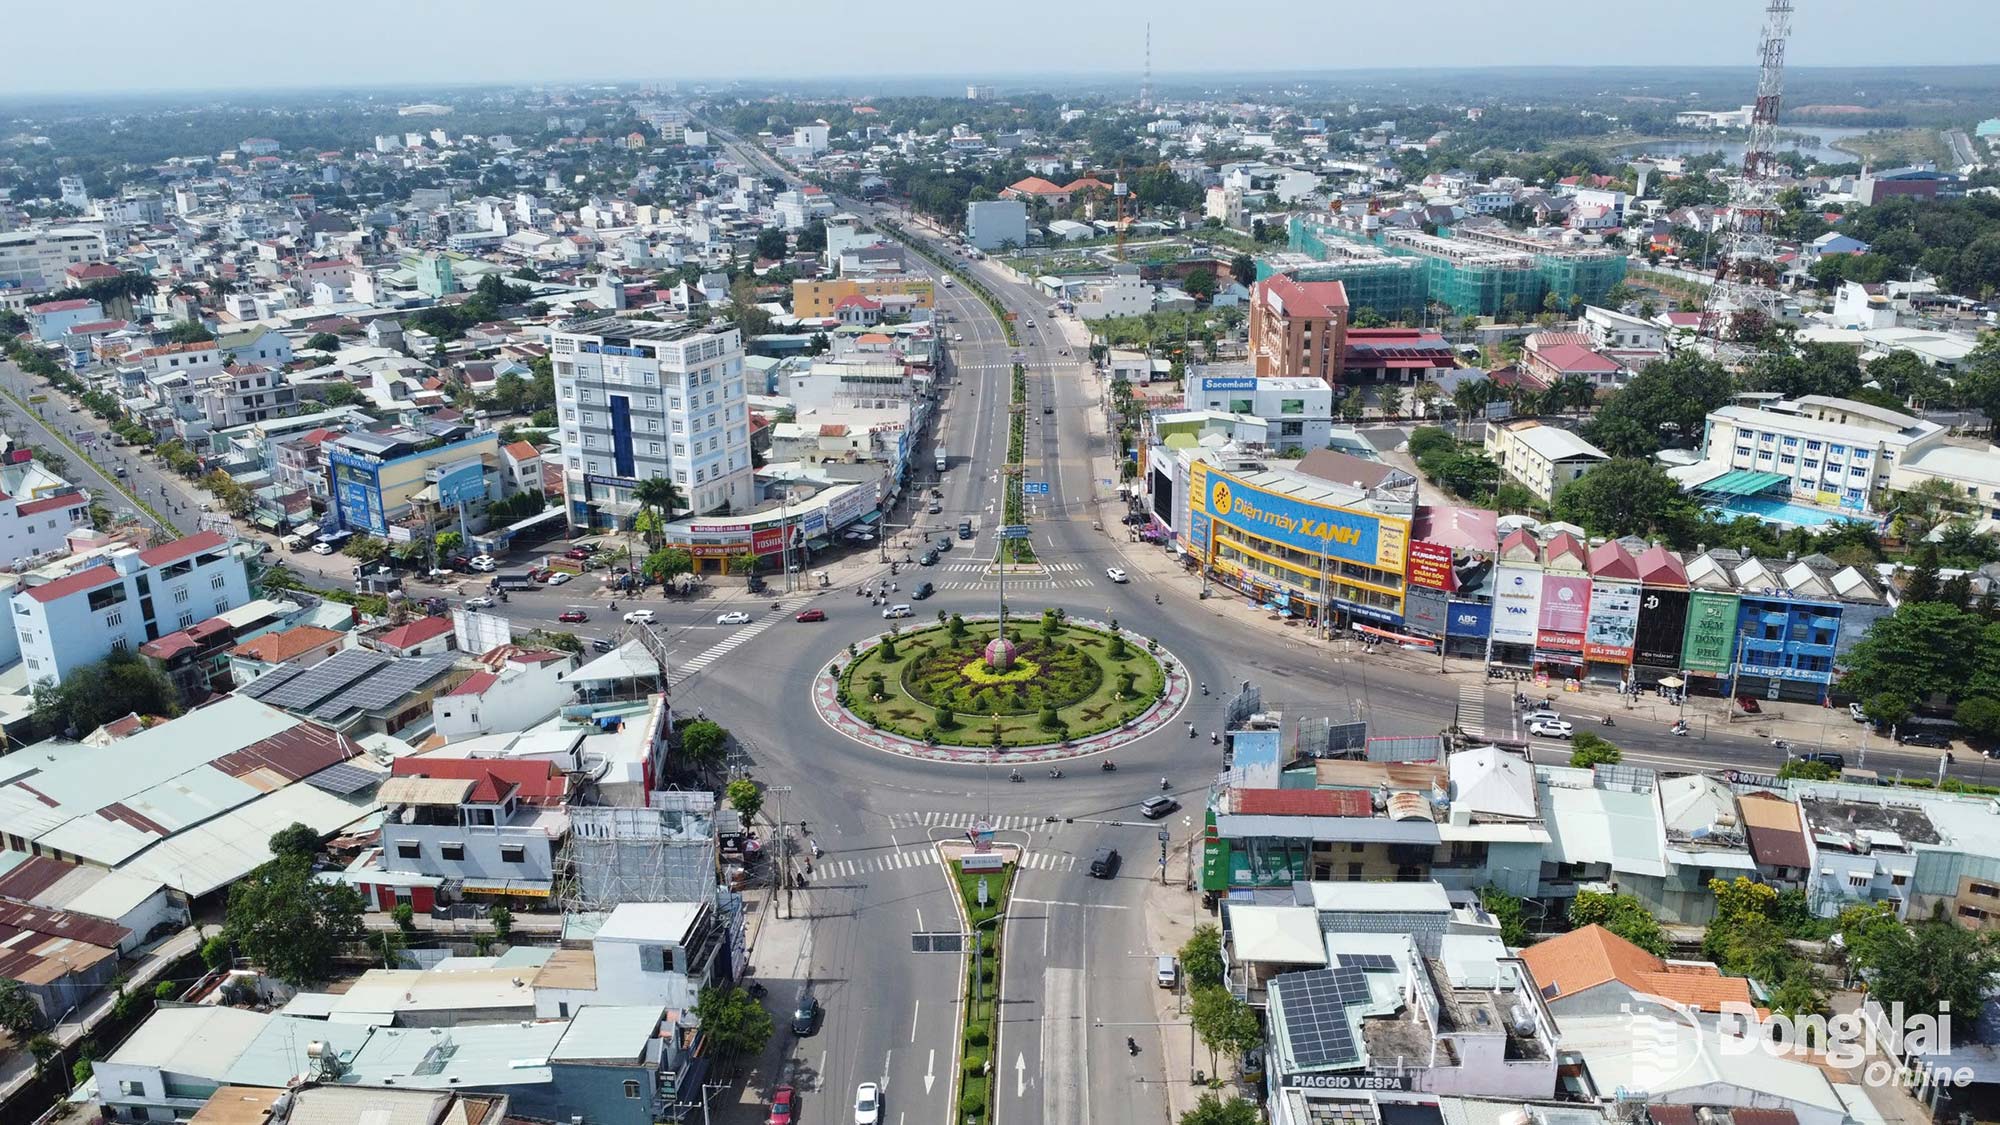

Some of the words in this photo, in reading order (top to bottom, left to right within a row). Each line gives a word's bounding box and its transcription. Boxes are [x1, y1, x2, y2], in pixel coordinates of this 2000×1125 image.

[1206, 379, 1254, 388] Sacombank
[1234, 497, 1263, 522] Điện
[1264, 511, 1299, 534] máy
[1300, 518, 1362, 546] XANH
[1458, 614, 1477, 623] ABC
[1292, 1076, 1350, 1088] PIAGGIO
[1354, 1077, 1402, 1089] VESPA
